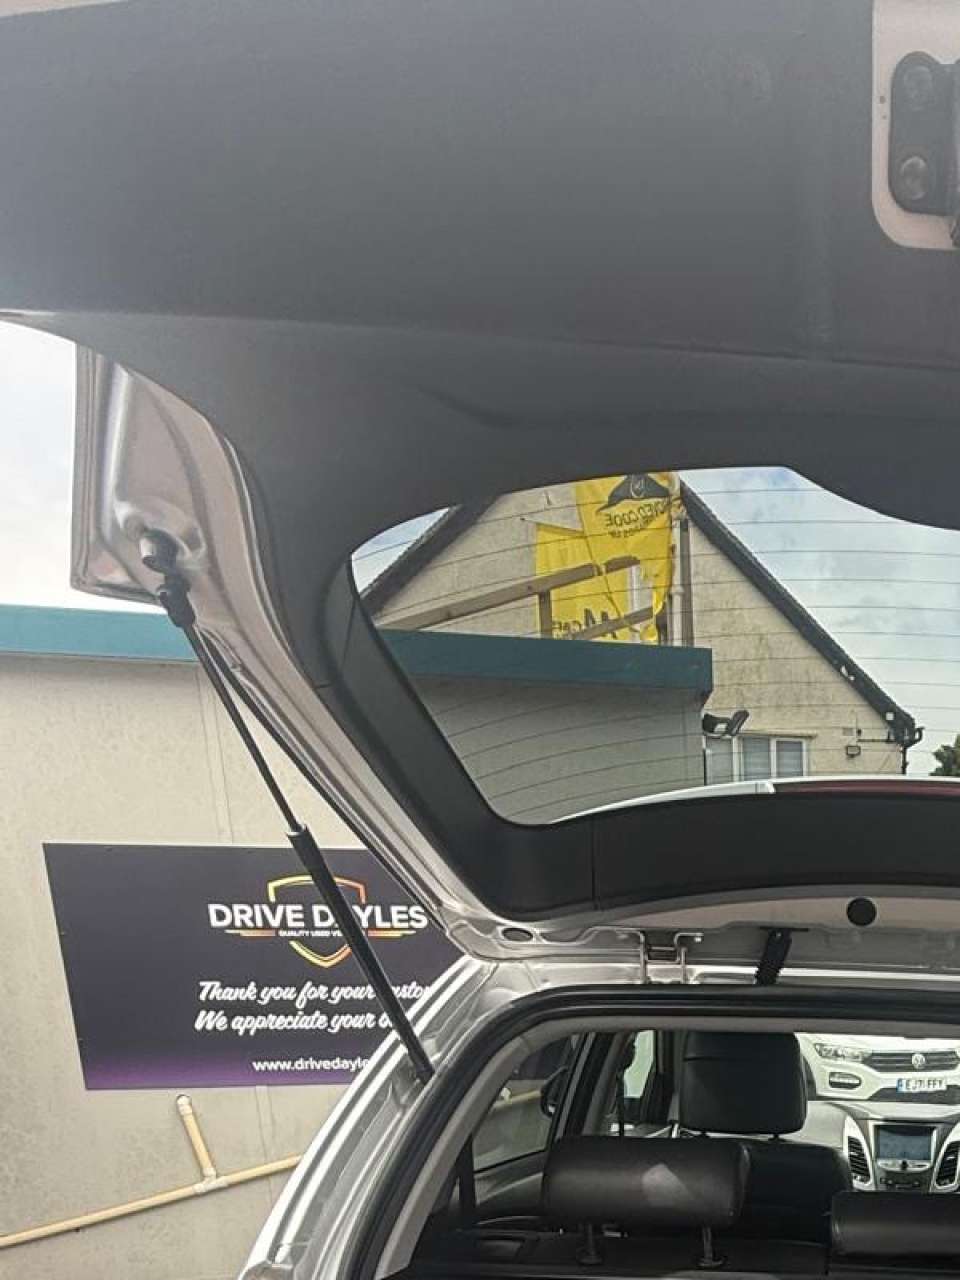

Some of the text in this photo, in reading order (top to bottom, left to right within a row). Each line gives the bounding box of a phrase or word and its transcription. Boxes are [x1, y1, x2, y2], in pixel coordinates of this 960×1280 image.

[208, 903, 428, 928] DRIVE DYLES
[199, 981, 257, 1001] Thank
[257, 985, 297, 1005] you
[296, 981, 328, 1009] for
[327, 984, 377, 1004] your
[195, 1010, 228, 1030] We
[231, 1010, 328, 1036] appreciate
[327, 1013, 376, 1033] your
